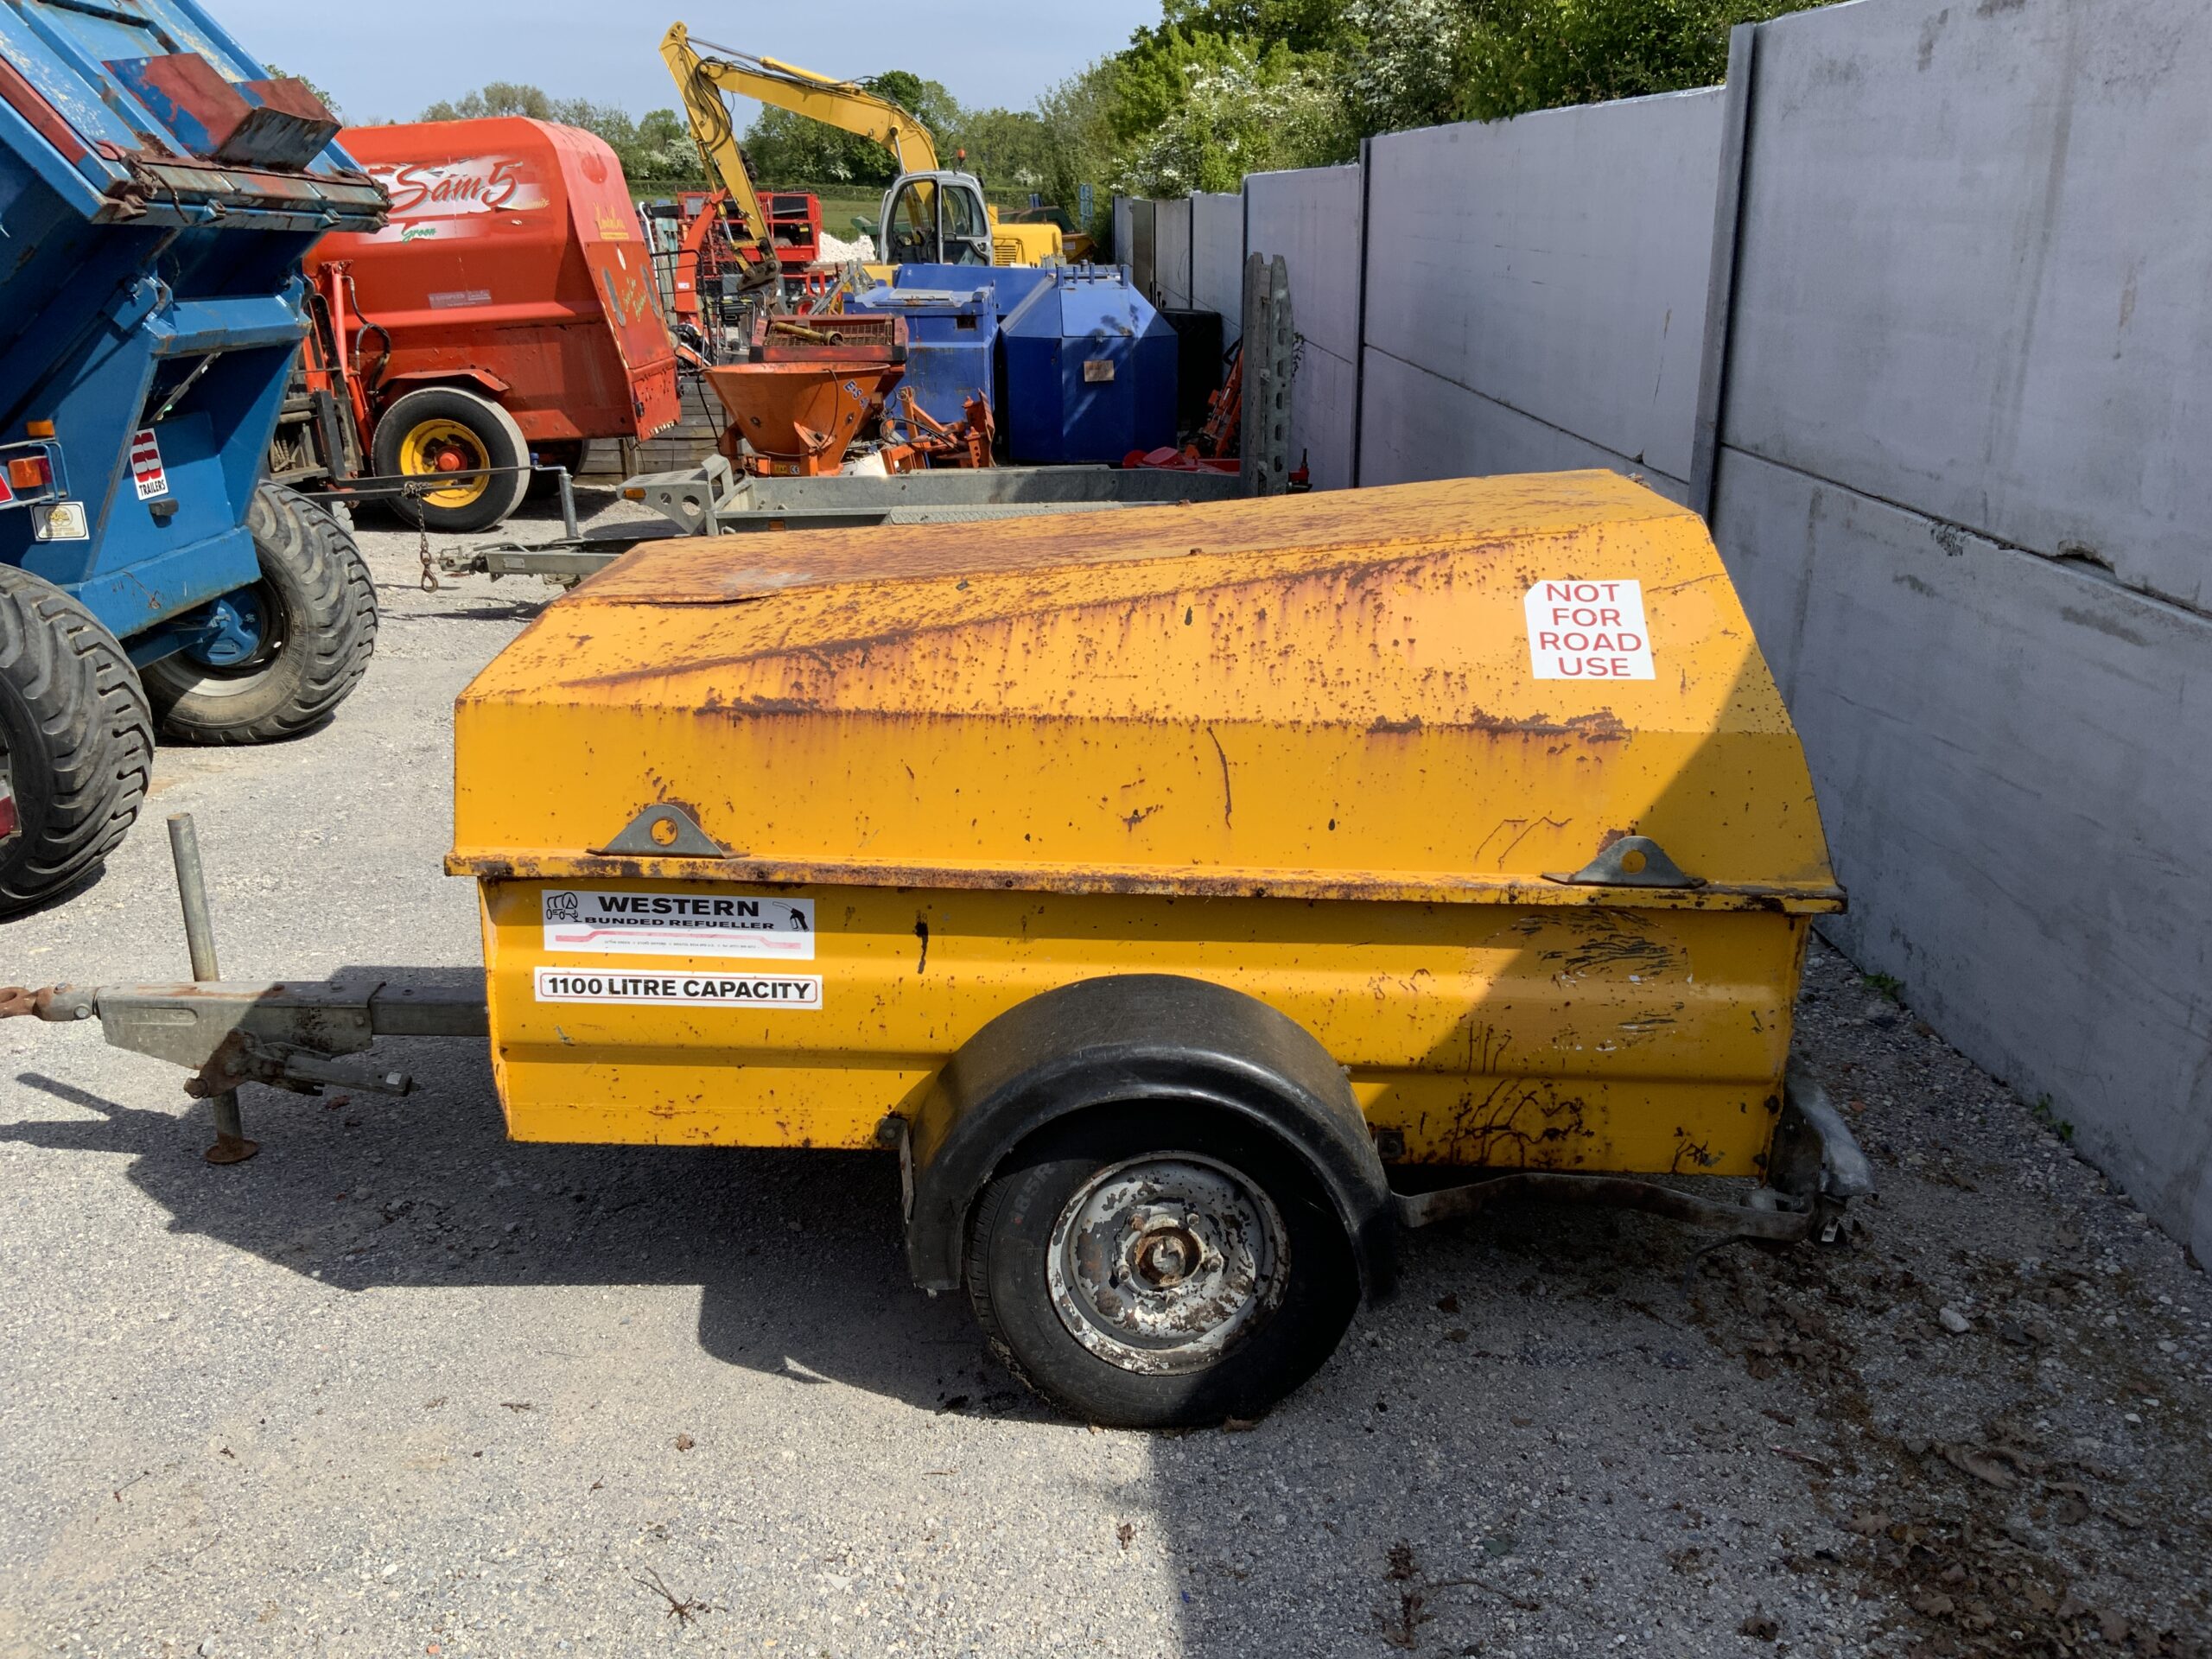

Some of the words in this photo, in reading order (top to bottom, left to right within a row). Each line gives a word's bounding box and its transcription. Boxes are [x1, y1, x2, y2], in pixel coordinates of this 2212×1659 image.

[481, 159, 524, 208] 5
[139, 480, 166, 496] TRAILERS
[1546, 583, 1620, 602] NOT
[1552, 607, 1622, 626] FOR
[1539, 632, 1642, 652] ROAD
[1558, 657, 1631, 677] USE
[598, 895, 760, 917] WESTERN
[584, 917, 664, 926] BUNDED
[669, 919, 774, 930] REFUELLER
[548, 977, 602, 995] 1100
[608, 978, 677, 997] LITRE
[683, 980, 811, 999] CAPACITY
